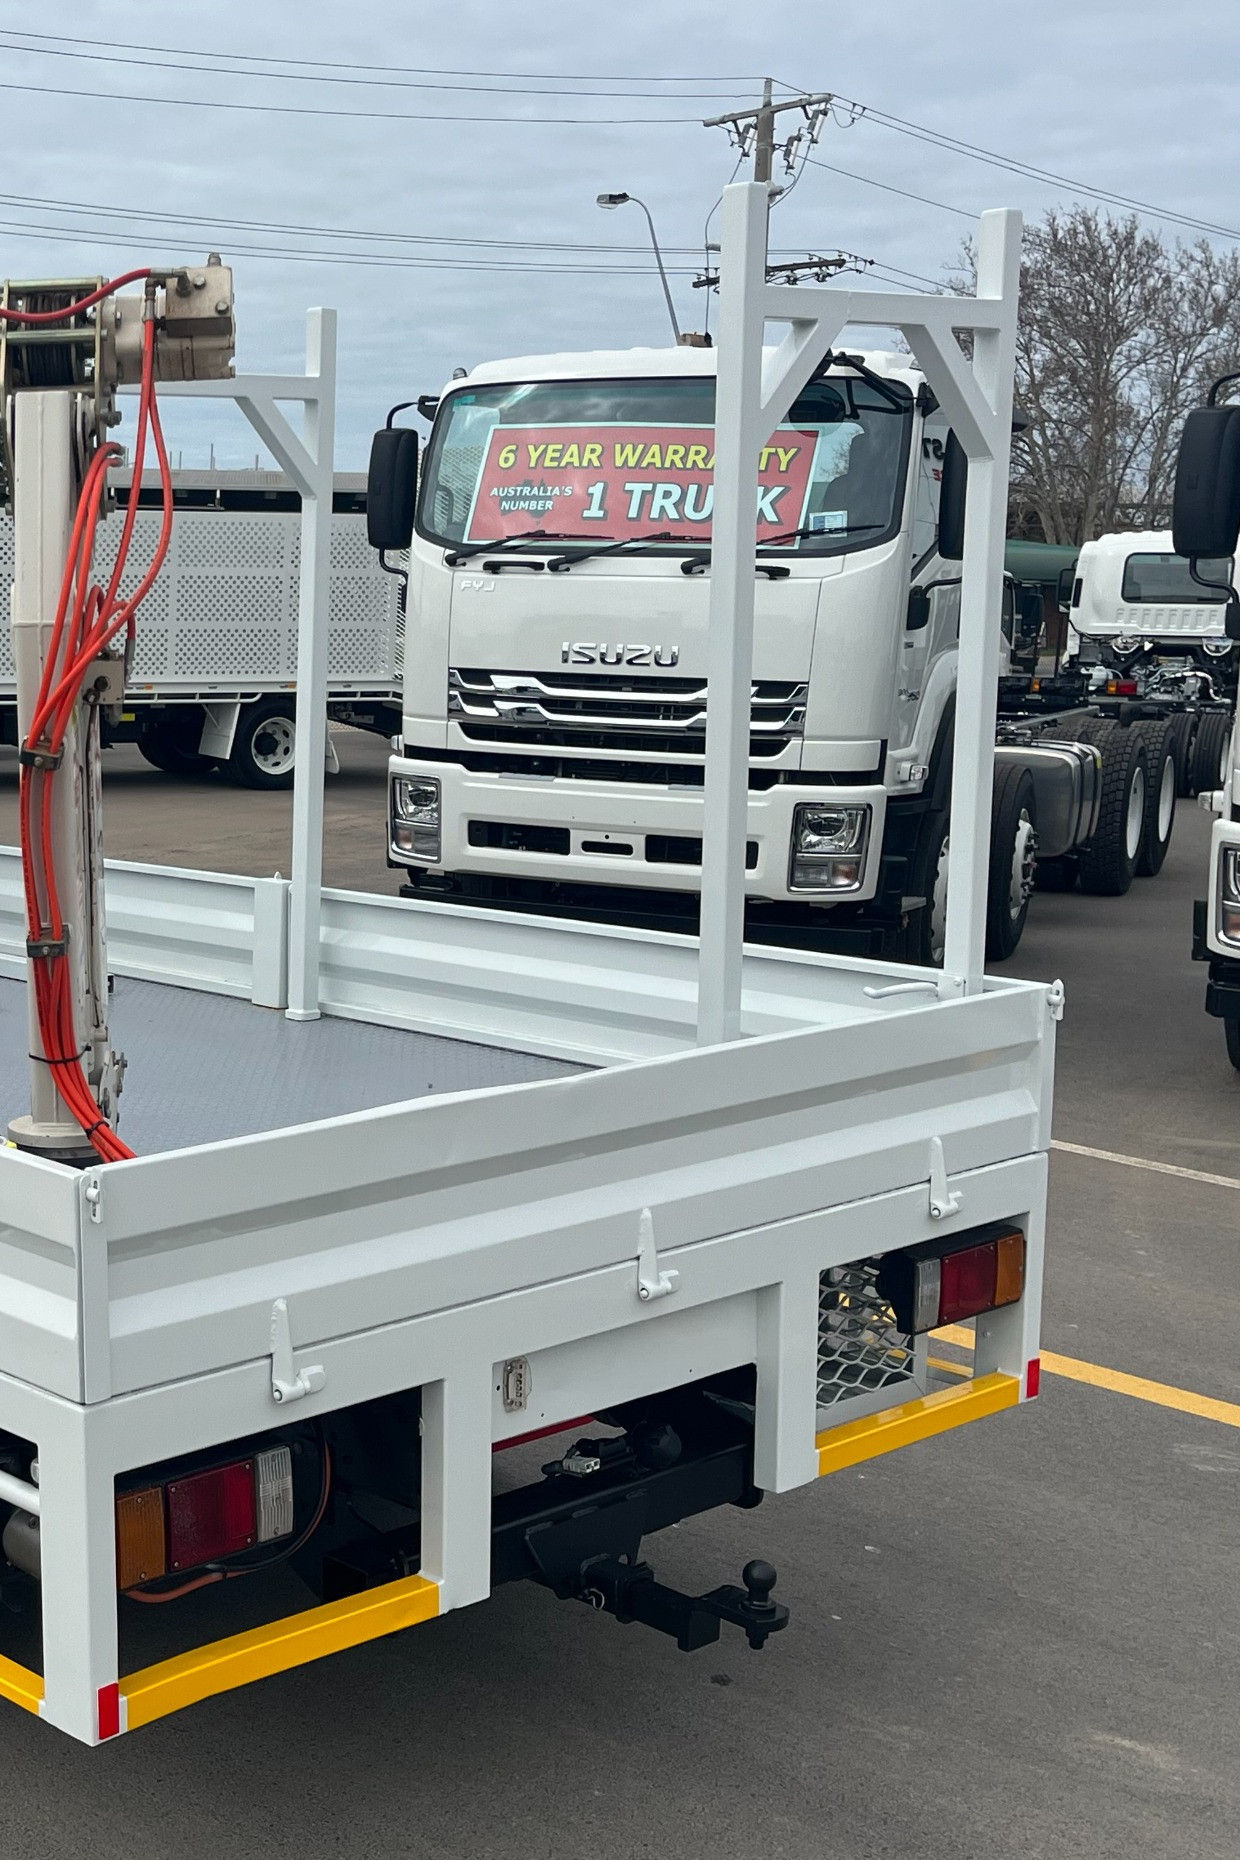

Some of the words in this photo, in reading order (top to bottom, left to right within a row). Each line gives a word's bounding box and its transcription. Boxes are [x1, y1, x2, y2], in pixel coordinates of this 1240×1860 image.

[498, 443, 517, 469] 6
[527, 442, 603, 468] YEAR
[614, 443, 798, 472] WARRTY
[489, 485, 573, 498] AUSTRALIA'S
[500, 499, 554, 512] NUMBER
[582, 481, 608, 519] 1
[624, 482, 786, 523] TRUK
[460, 580, 496, 592] FYJ
[561, 641, 680, 667] ISUZU
